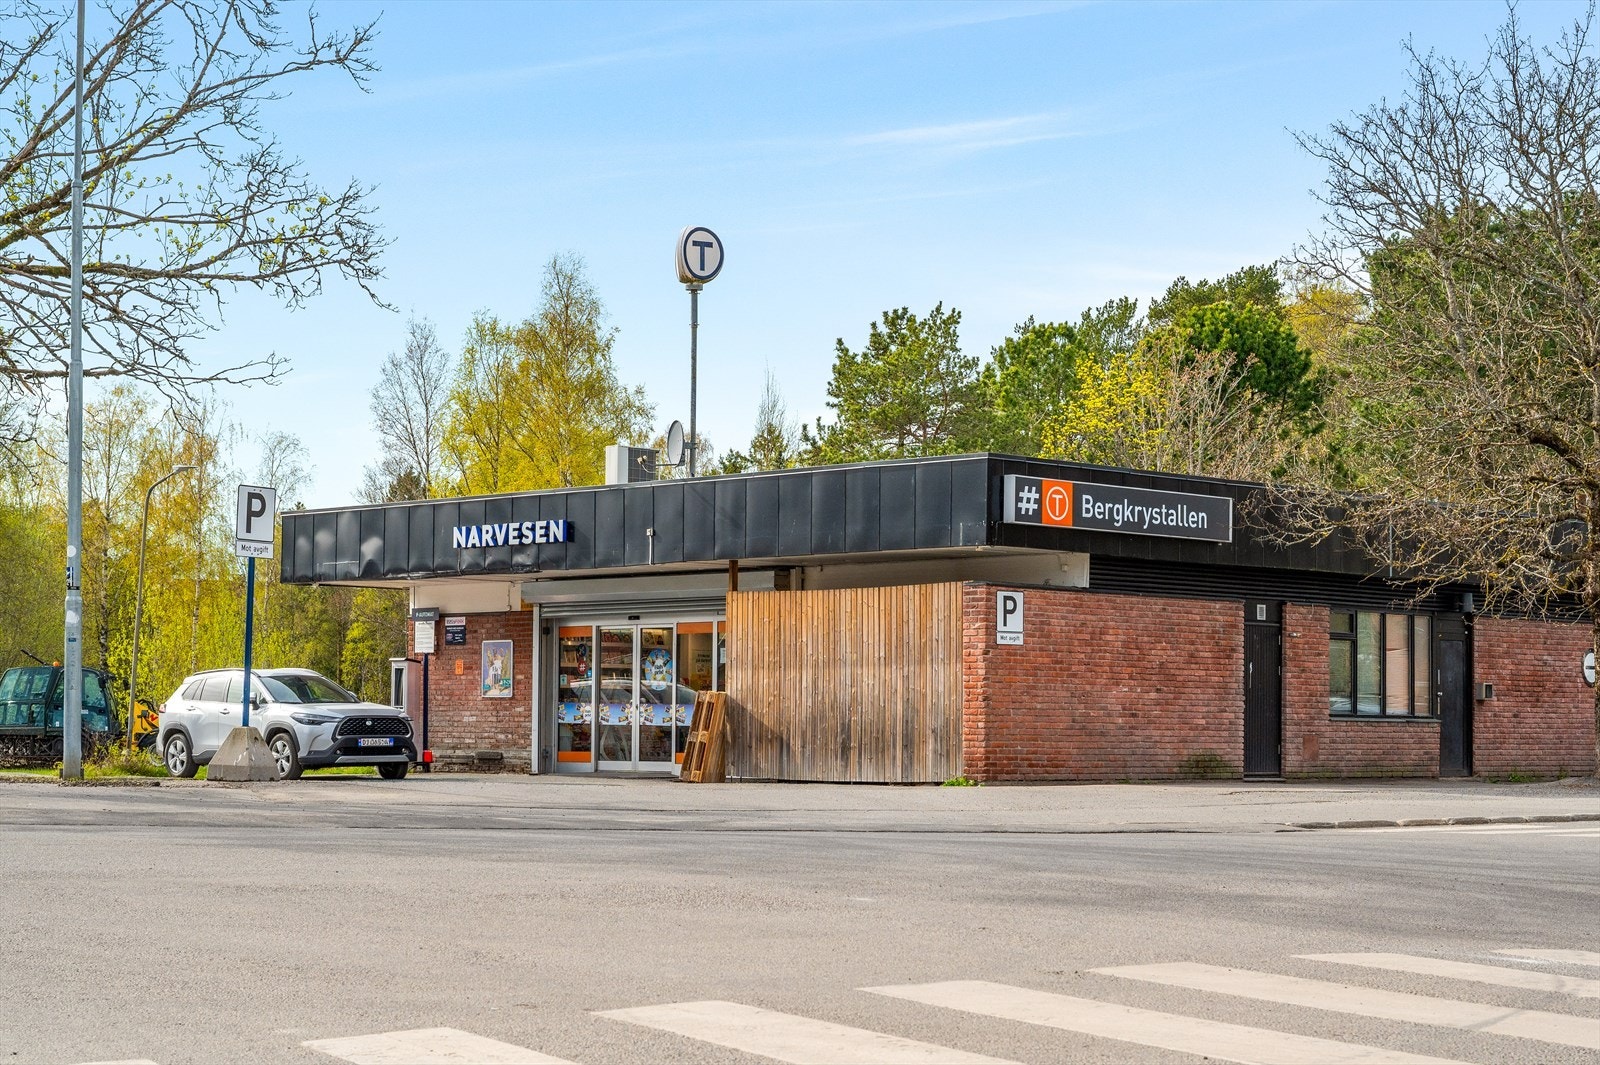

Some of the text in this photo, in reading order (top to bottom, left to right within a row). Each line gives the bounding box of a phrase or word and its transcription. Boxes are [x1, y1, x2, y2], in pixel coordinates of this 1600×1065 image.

[691, 240, 713, 271] T
[246, 491, 267, 534] P
[1081, 493, 1208, 530] Bergkrystallen
[241, 544, 269, 555] Mot avgift
[452, 519, 566, 549] NARVESEN
[1002, 595, 1018, 627] P
